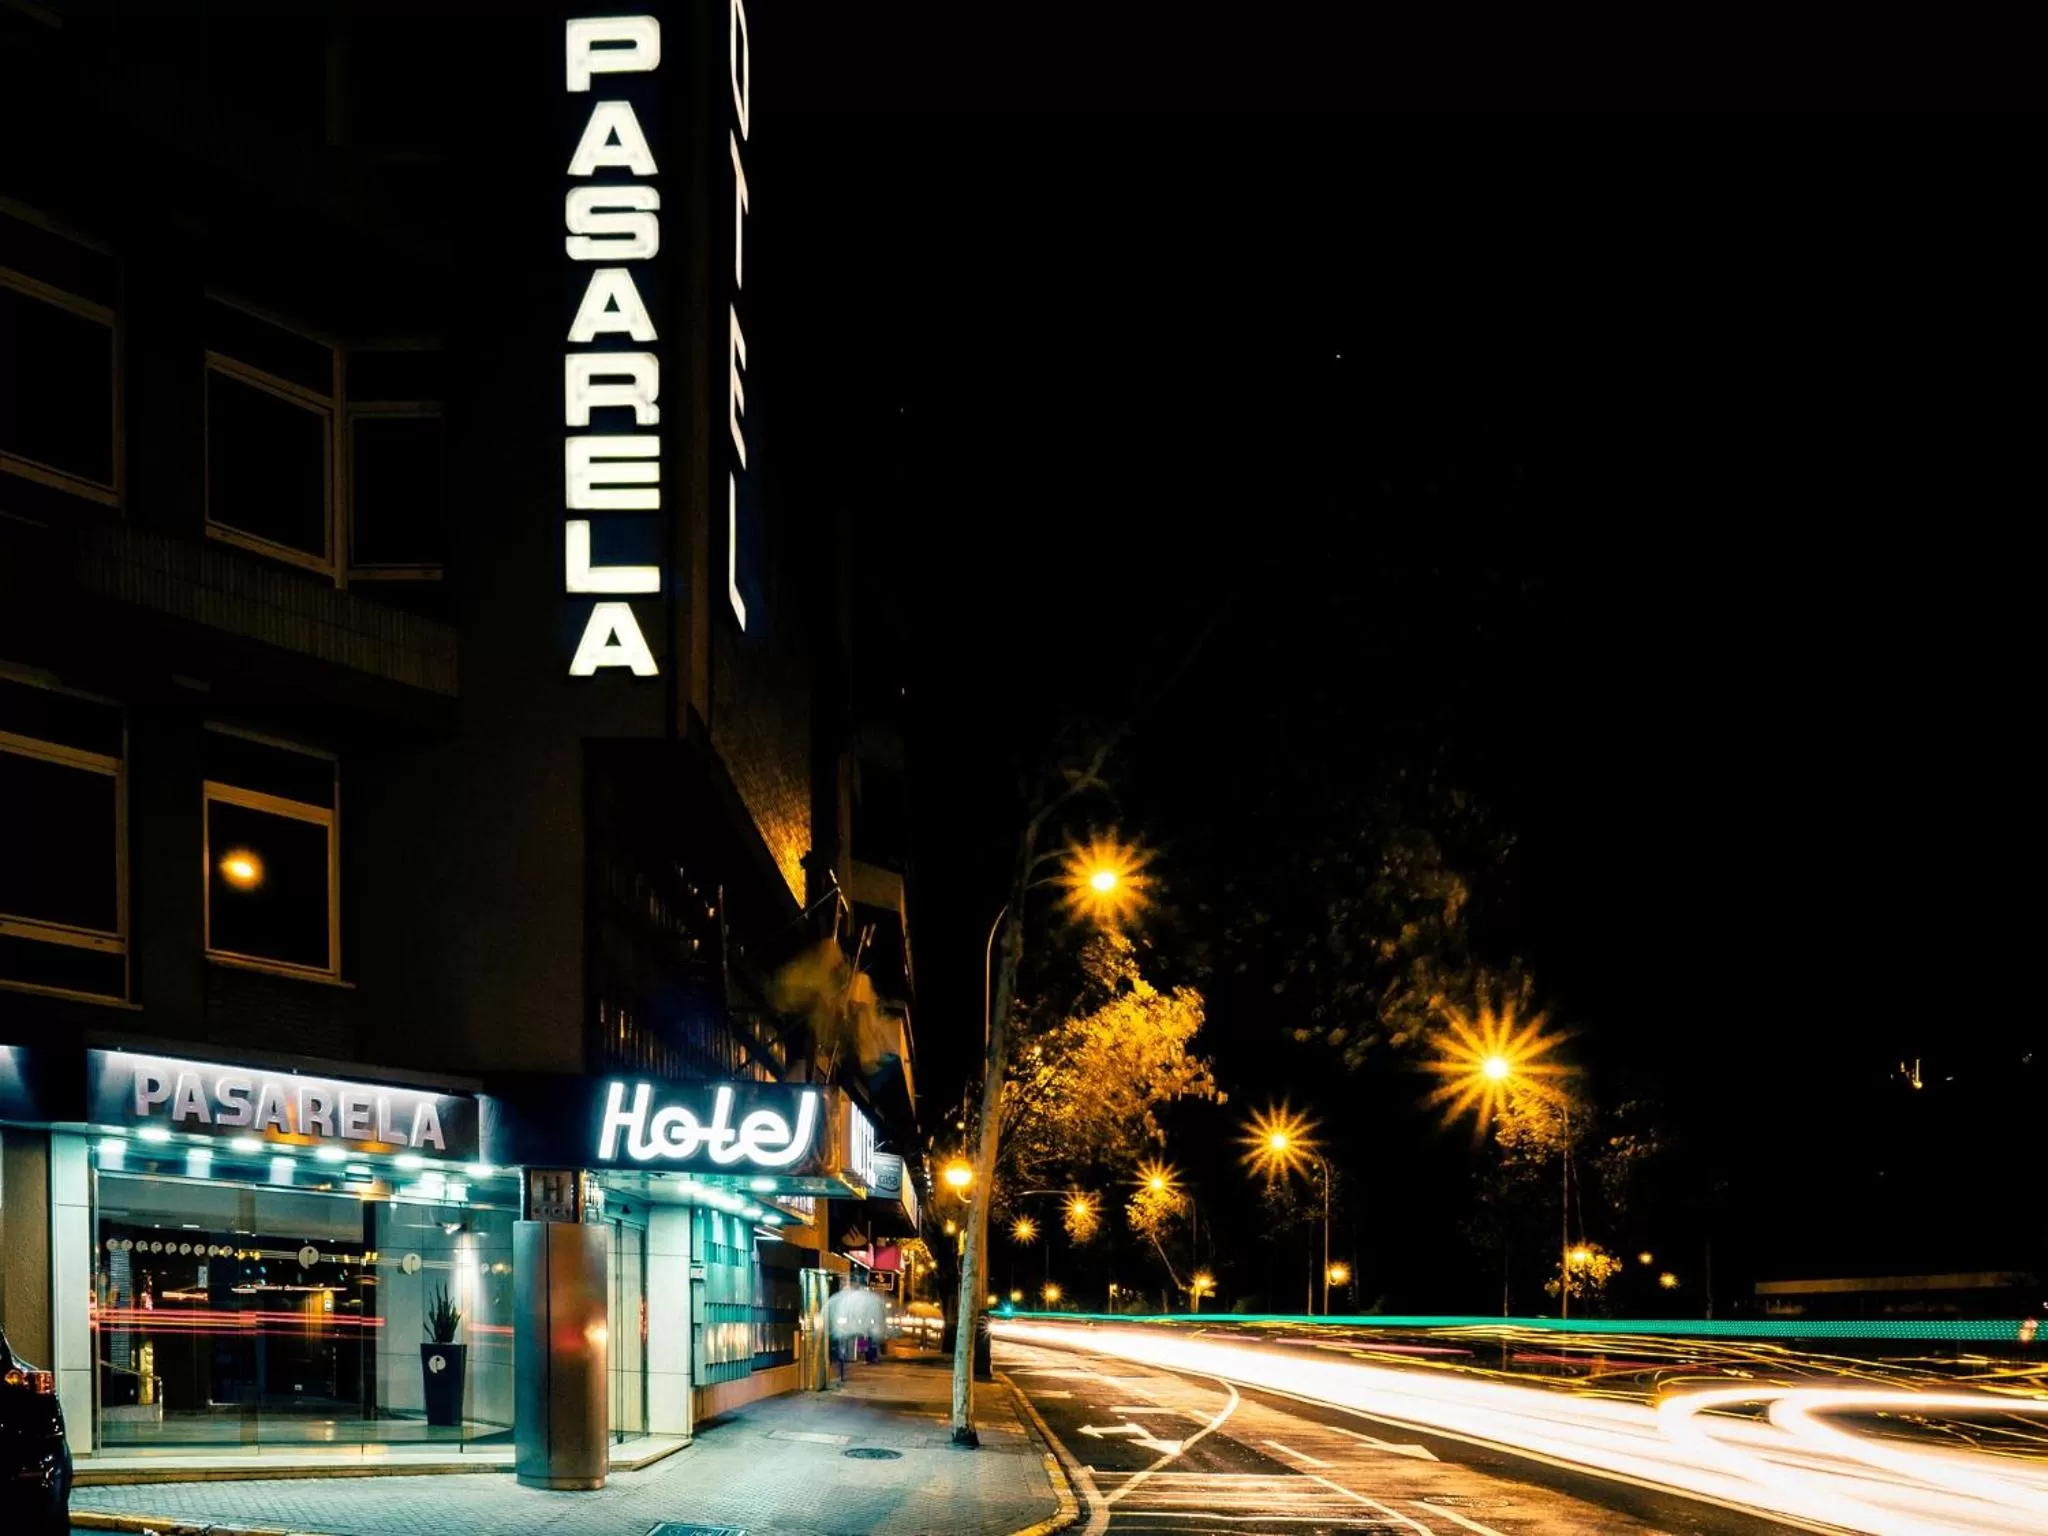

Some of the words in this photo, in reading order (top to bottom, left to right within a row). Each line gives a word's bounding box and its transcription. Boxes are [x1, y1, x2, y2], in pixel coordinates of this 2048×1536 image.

[566, 15, 660, 677] PASARELA
[134, 1063, 446, 1151] PASARELA
[598, 1081, 817, 1167] Hotel
